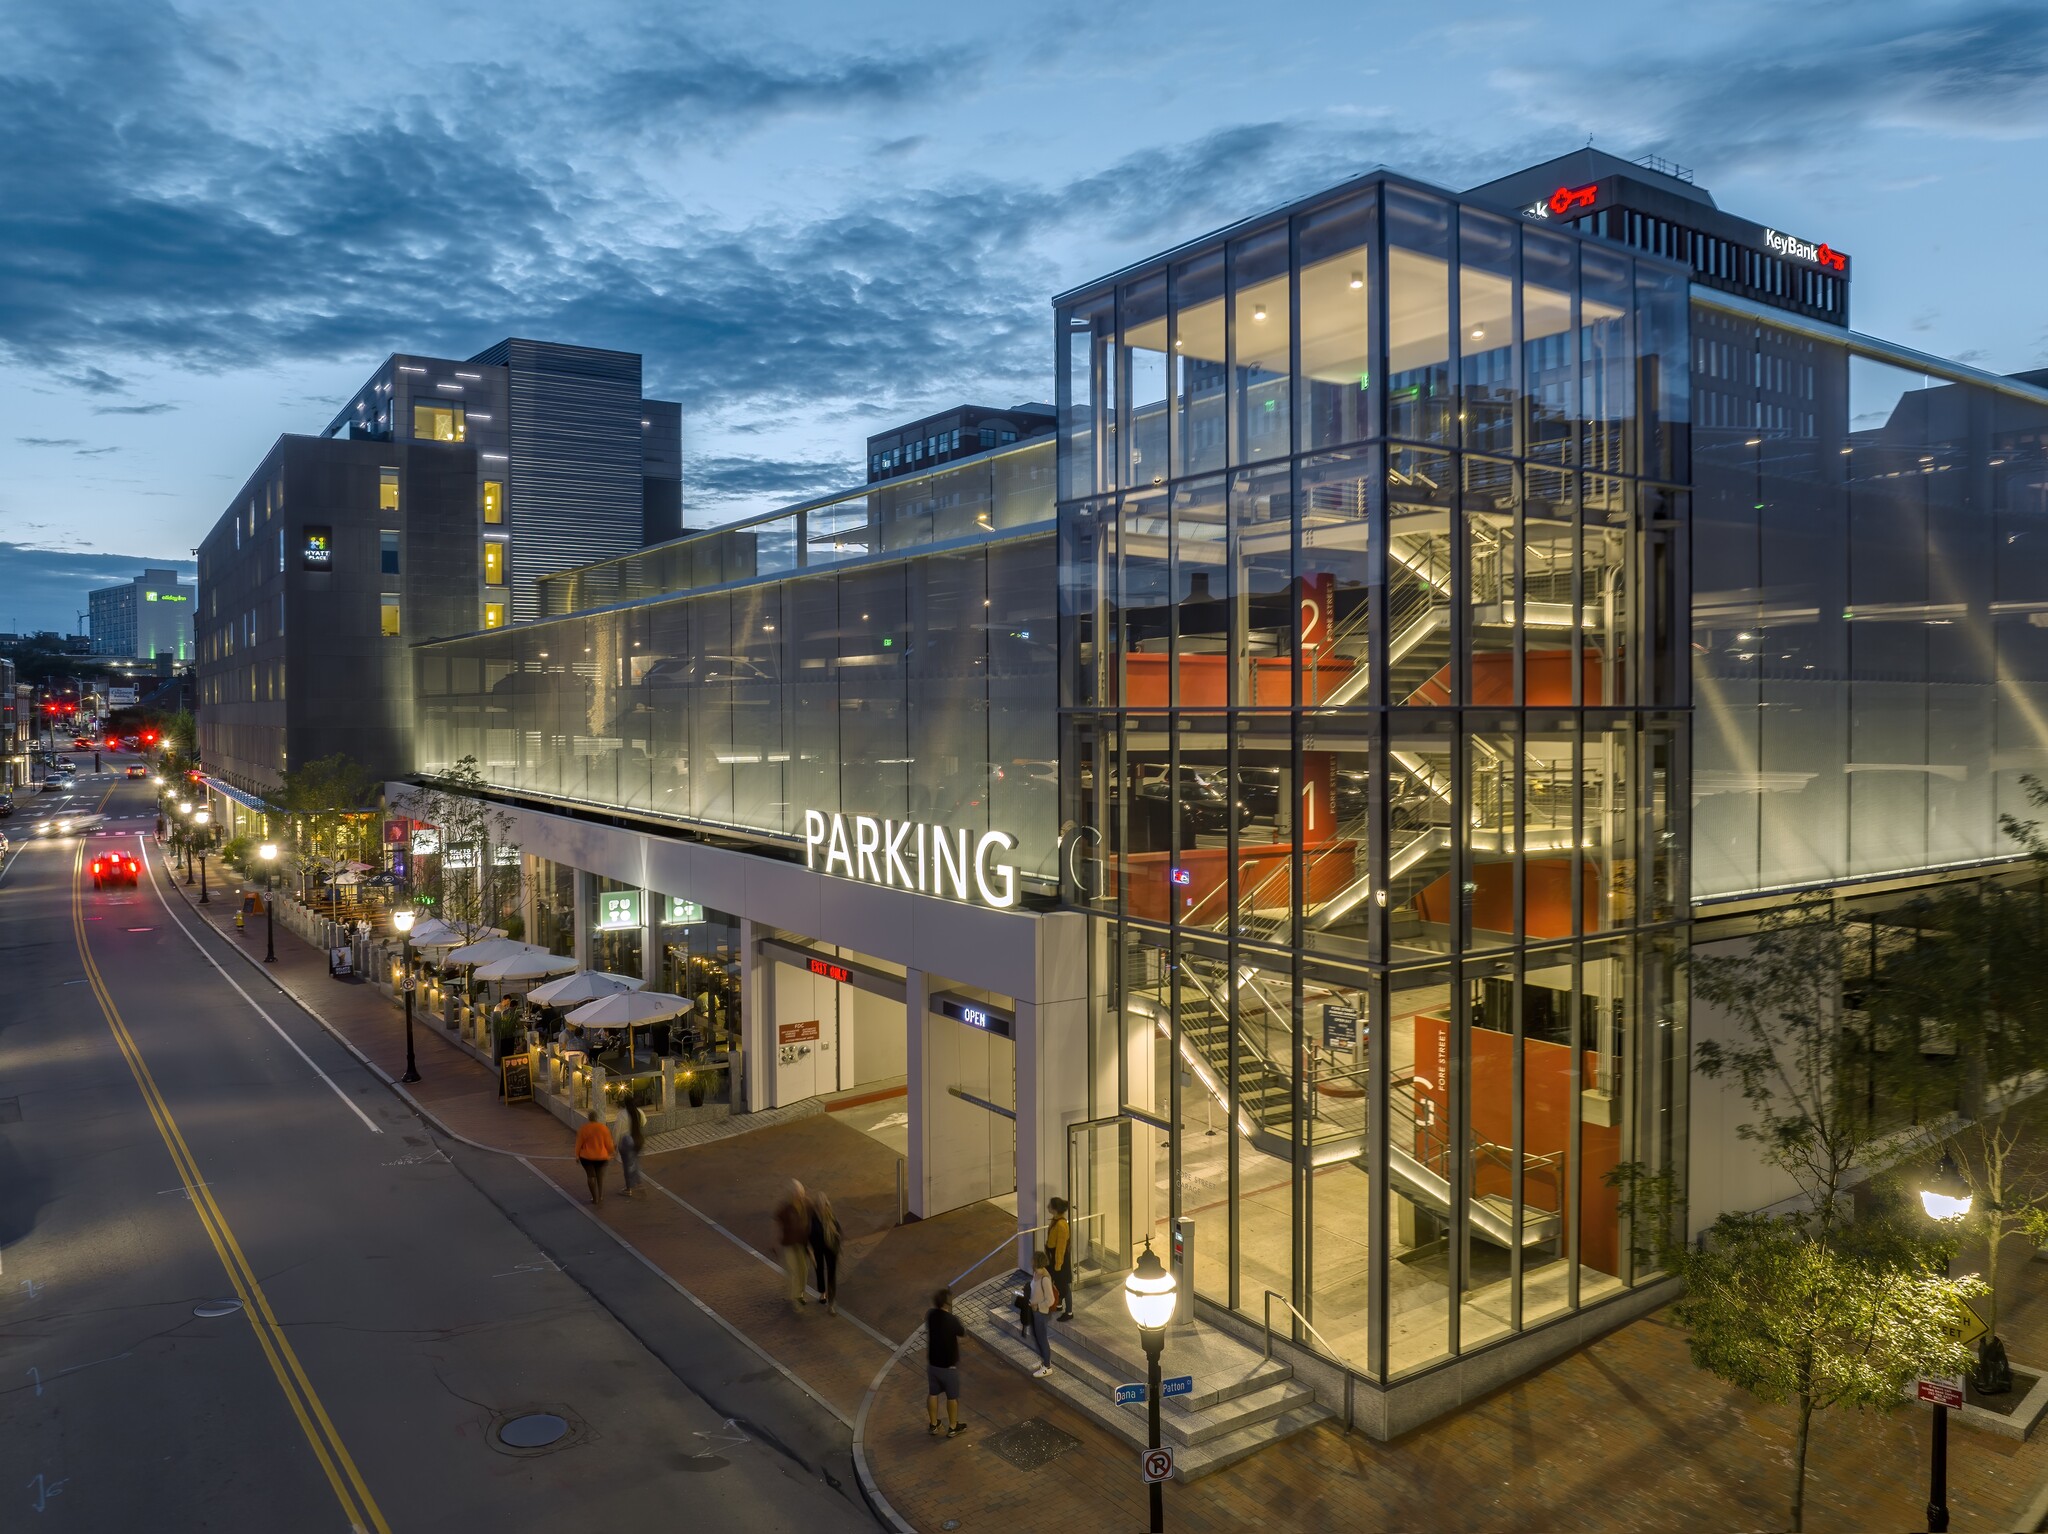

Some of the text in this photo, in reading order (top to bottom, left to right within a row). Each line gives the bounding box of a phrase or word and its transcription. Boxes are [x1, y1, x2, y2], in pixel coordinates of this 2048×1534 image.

[1766, 228, 1819, 263] KeyBank
[1326, 582, 1334, 642] FORE STREET
[1301, 598, 1320, 650] 2
[1329, 754, 1337, 814] FORE STREET
[1302, 780, 1315, 831] 1
[805, 809, 1021, 908] PARKING
[608, 899, 631, 911] FU
[608, 910, 631, 922] TO
[811, 959, 848, 982] EXIT ONLY
[964, 1008, 986, 1027] OPEN
[1438, 1029, 1446, 1091] FORE STREET
[1176, 1169, 1216, 1190] FORE STREET
[1176, 1180, 1201, 1195] GARAGE
[1116, 1390, 1136, 1402] Dana
[1163, 1382, 1185, 1394] Patton
